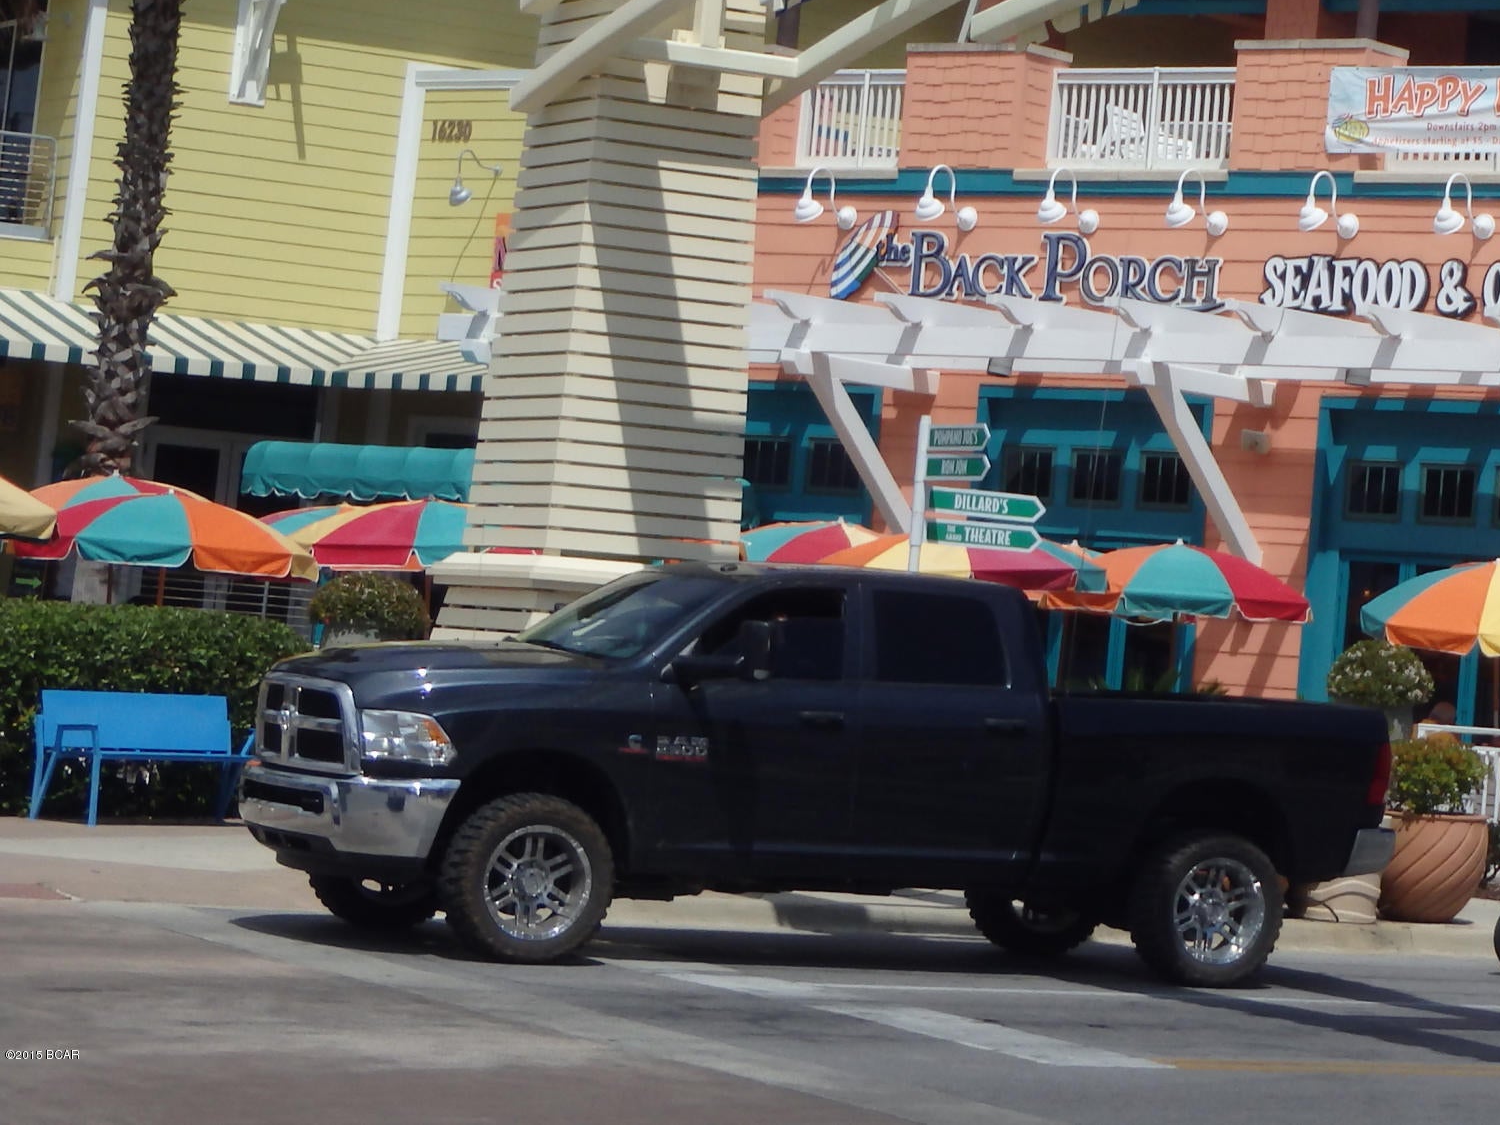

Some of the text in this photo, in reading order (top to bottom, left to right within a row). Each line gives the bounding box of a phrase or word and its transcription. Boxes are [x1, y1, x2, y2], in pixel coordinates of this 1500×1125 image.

[1365, 73, 1487, 119] HAPPY
[432, 119, 473, 144] 16230
[1426, 121, 1475, 132] Downstairs
[1478, 121, 1497, 133] 2pm
[876, 230, 1223, 309] the BACK PORCH
[1259, 254, 1431, 315] SEAFOOD
[1435, 258, 1477, 319] &
[953, 494, 1009, 514] DILLARD'S
[964, 525, 1012, 546] THEATRE
